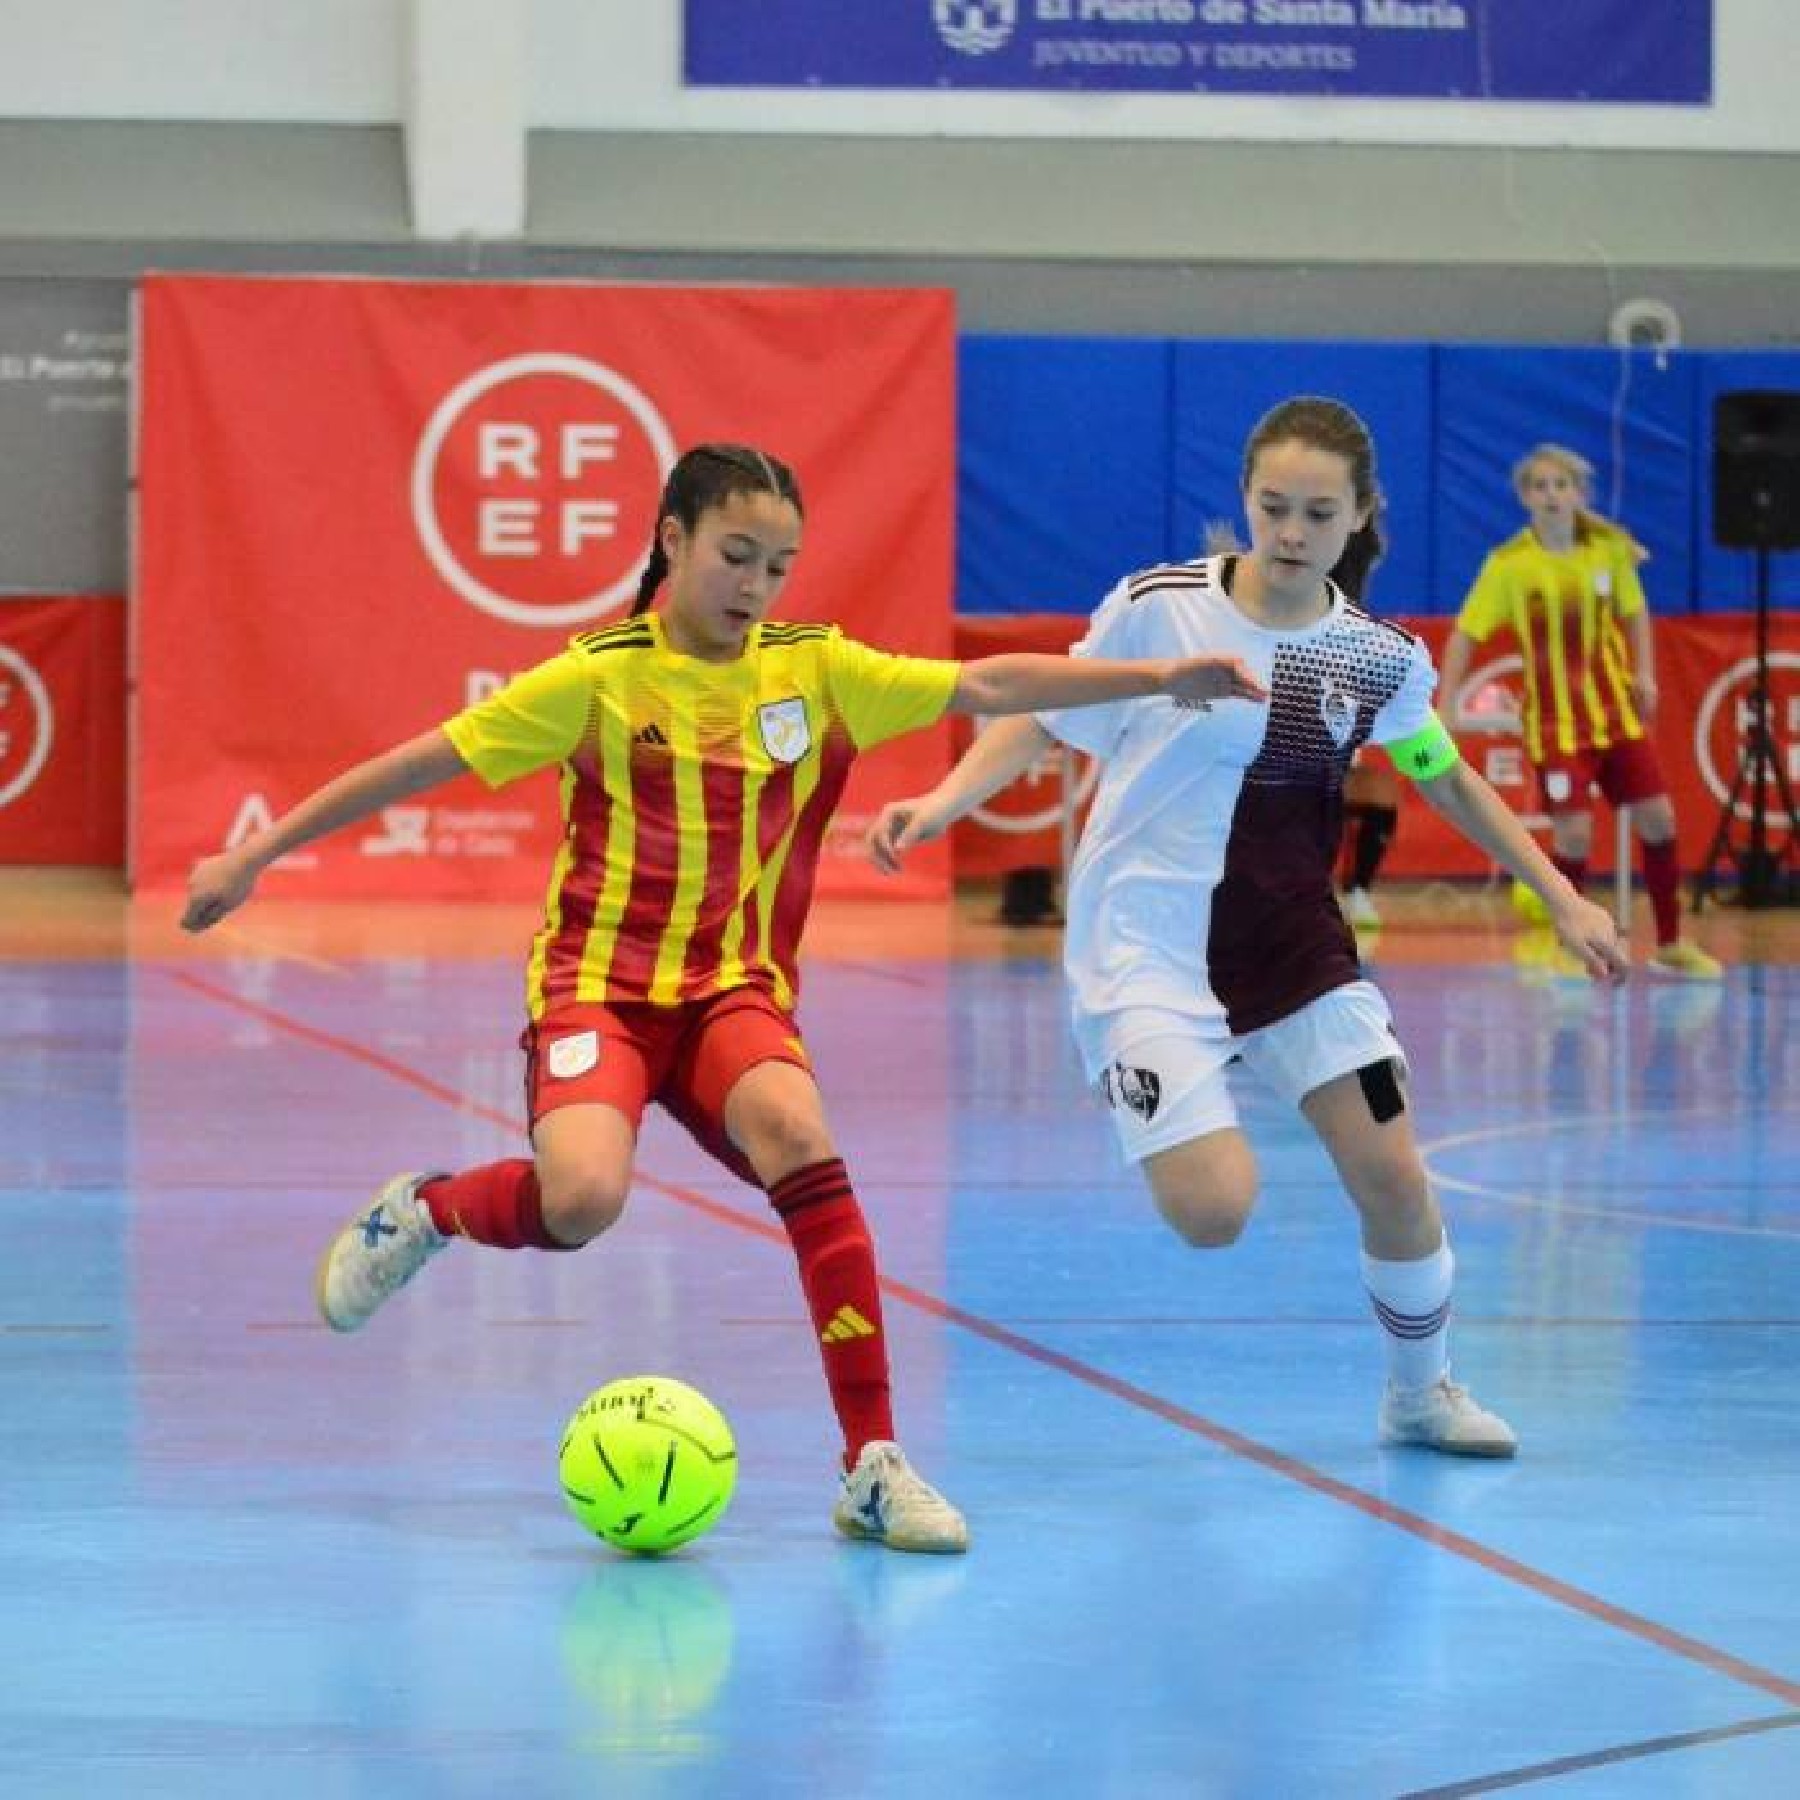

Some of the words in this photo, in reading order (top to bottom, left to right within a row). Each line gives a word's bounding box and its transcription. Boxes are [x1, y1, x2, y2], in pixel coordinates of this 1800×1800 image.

[1080, 0, 1195, 23] Puerto
[1201, 0, 1248, 24] de
[1253, 0, 1357, 26] Santa
[1033, 40, 1182, 67] JUVENTUD
[1184, 42, 1208, 67] Y
[1213, 44, 1357, 71] DEPORTES
[479, 423, 619, 479] RF
[479, 500, 619, 556] EF
